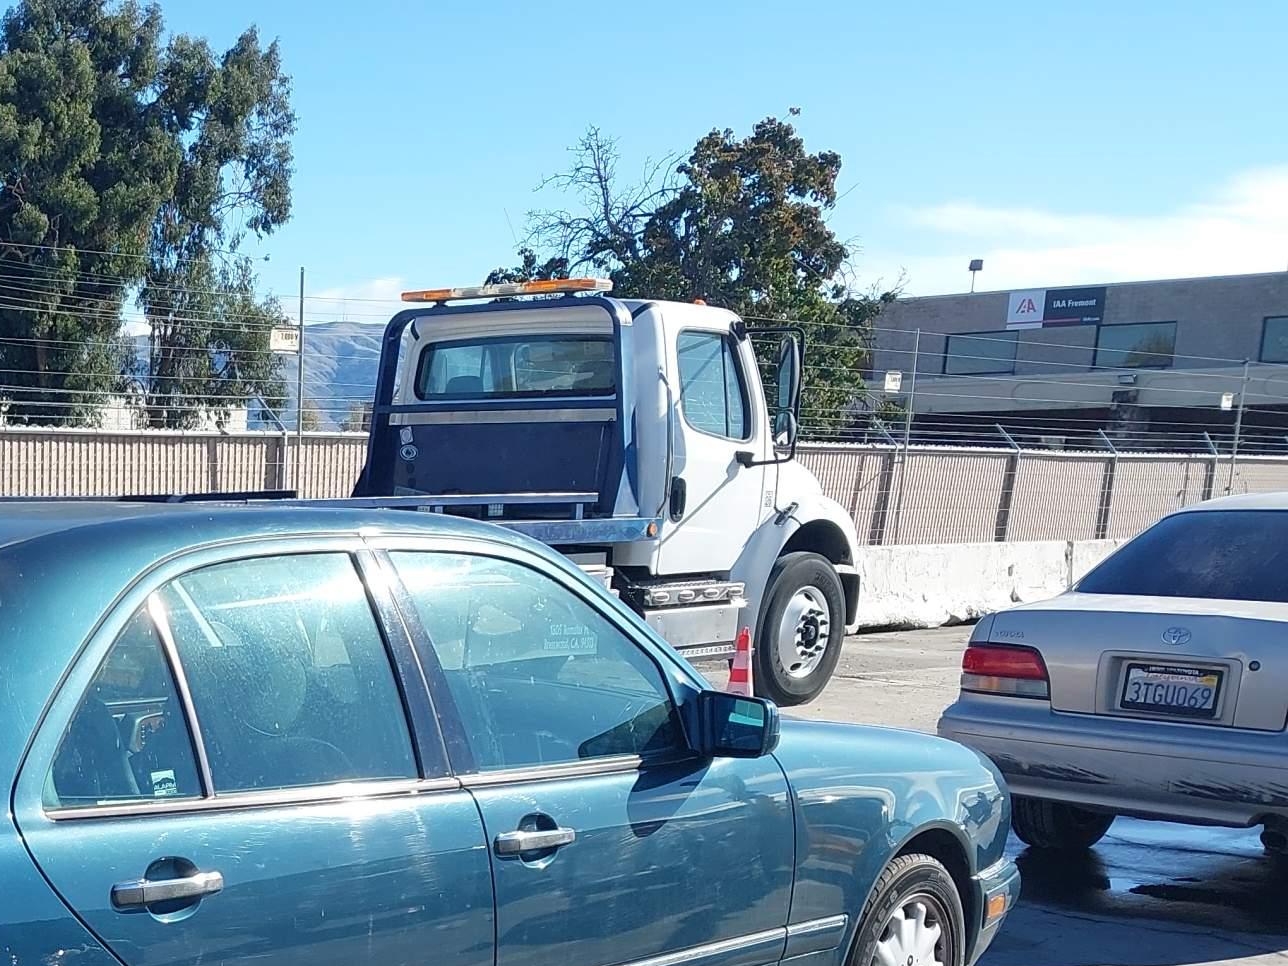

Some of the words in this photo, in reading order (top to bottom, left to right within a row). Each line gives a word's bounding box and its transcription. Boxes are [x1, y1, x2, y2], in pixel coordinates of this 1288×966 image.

[1053, 299, 1066, 309] IAA
[1068, 299, 1096, 308] Fremont
[1129, 682, 1212, 710] 3TGU069
